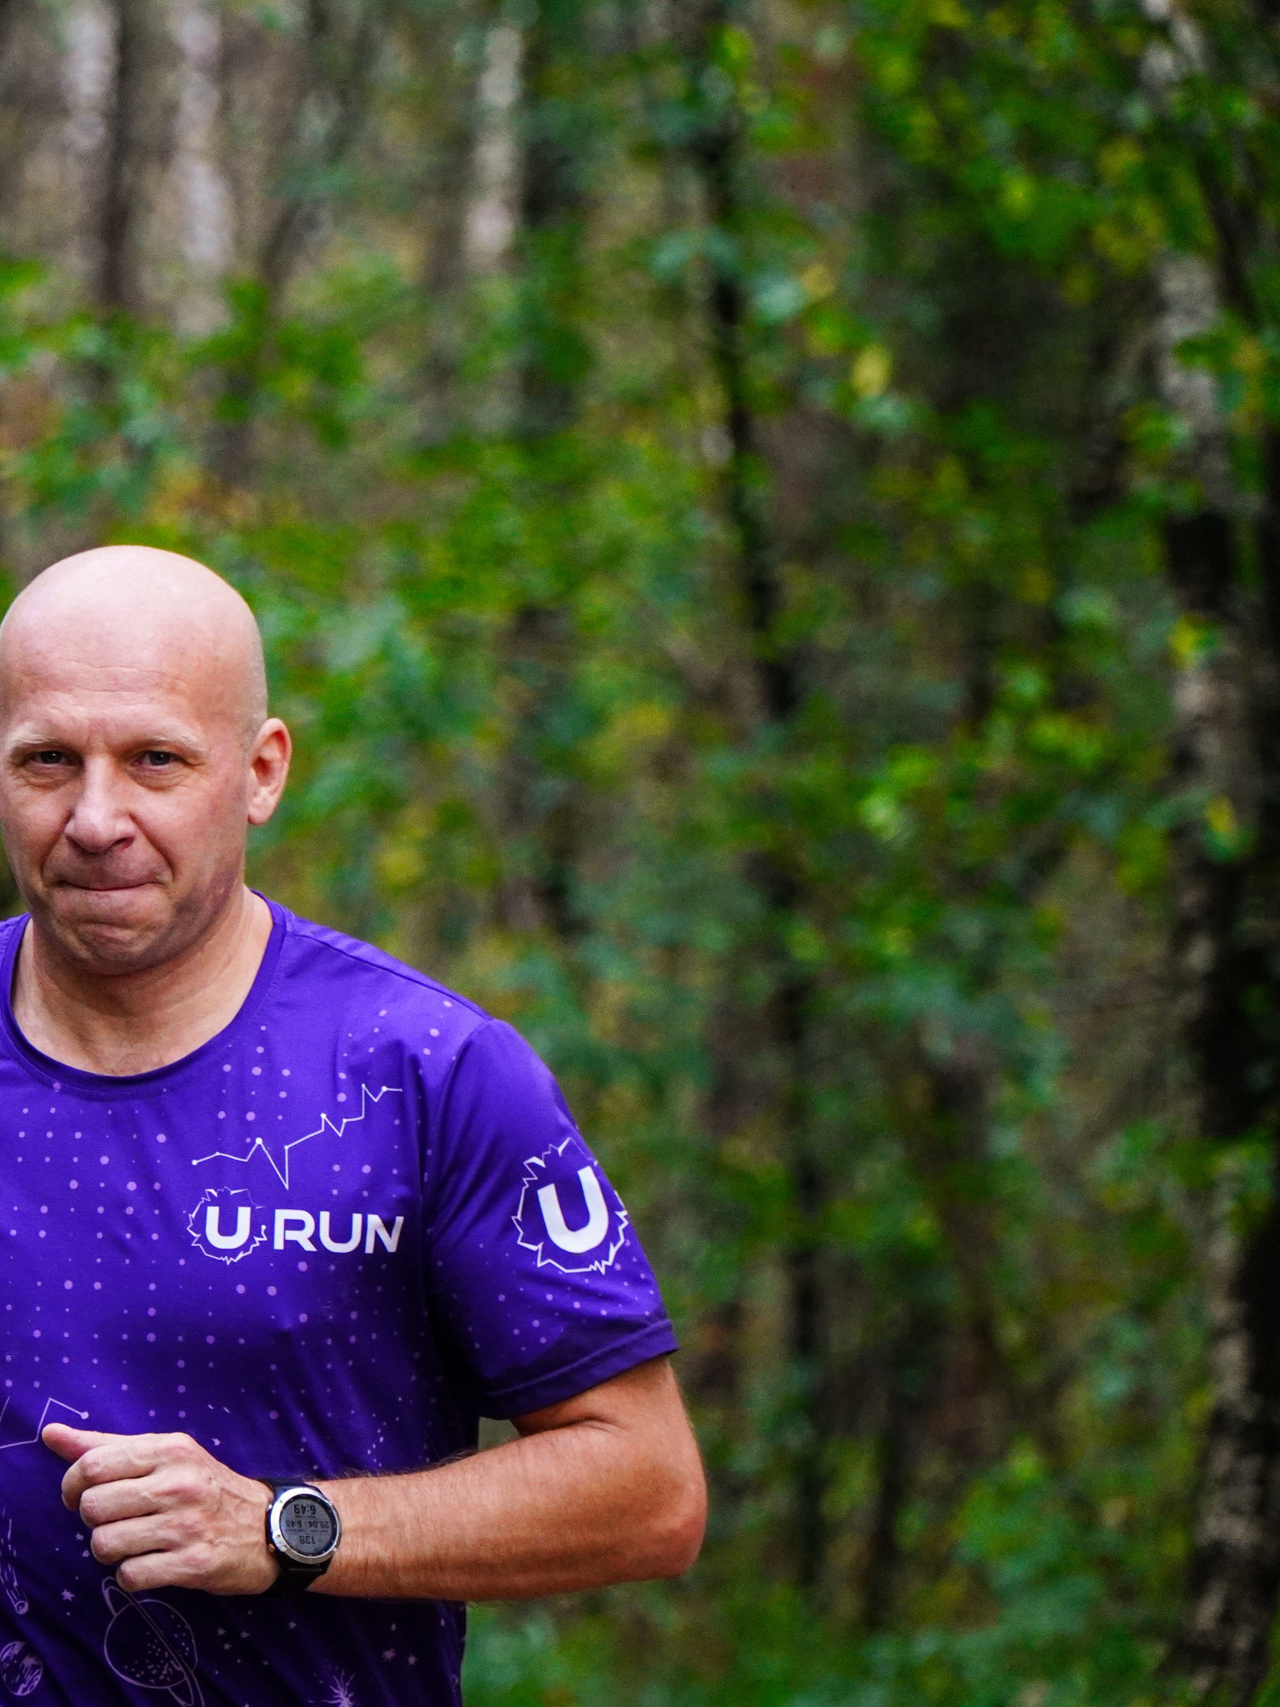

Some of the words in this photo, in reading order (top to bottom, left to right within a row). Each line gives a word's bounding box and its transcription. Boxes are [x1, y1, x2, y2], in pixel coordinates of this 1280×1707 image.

[205, 1205, 252, 1249] U
[273, 1208, 405, 1254] RUN
[536, 1165, 609, 1254] U
[293, 1504, 316, 1515] 6:49
